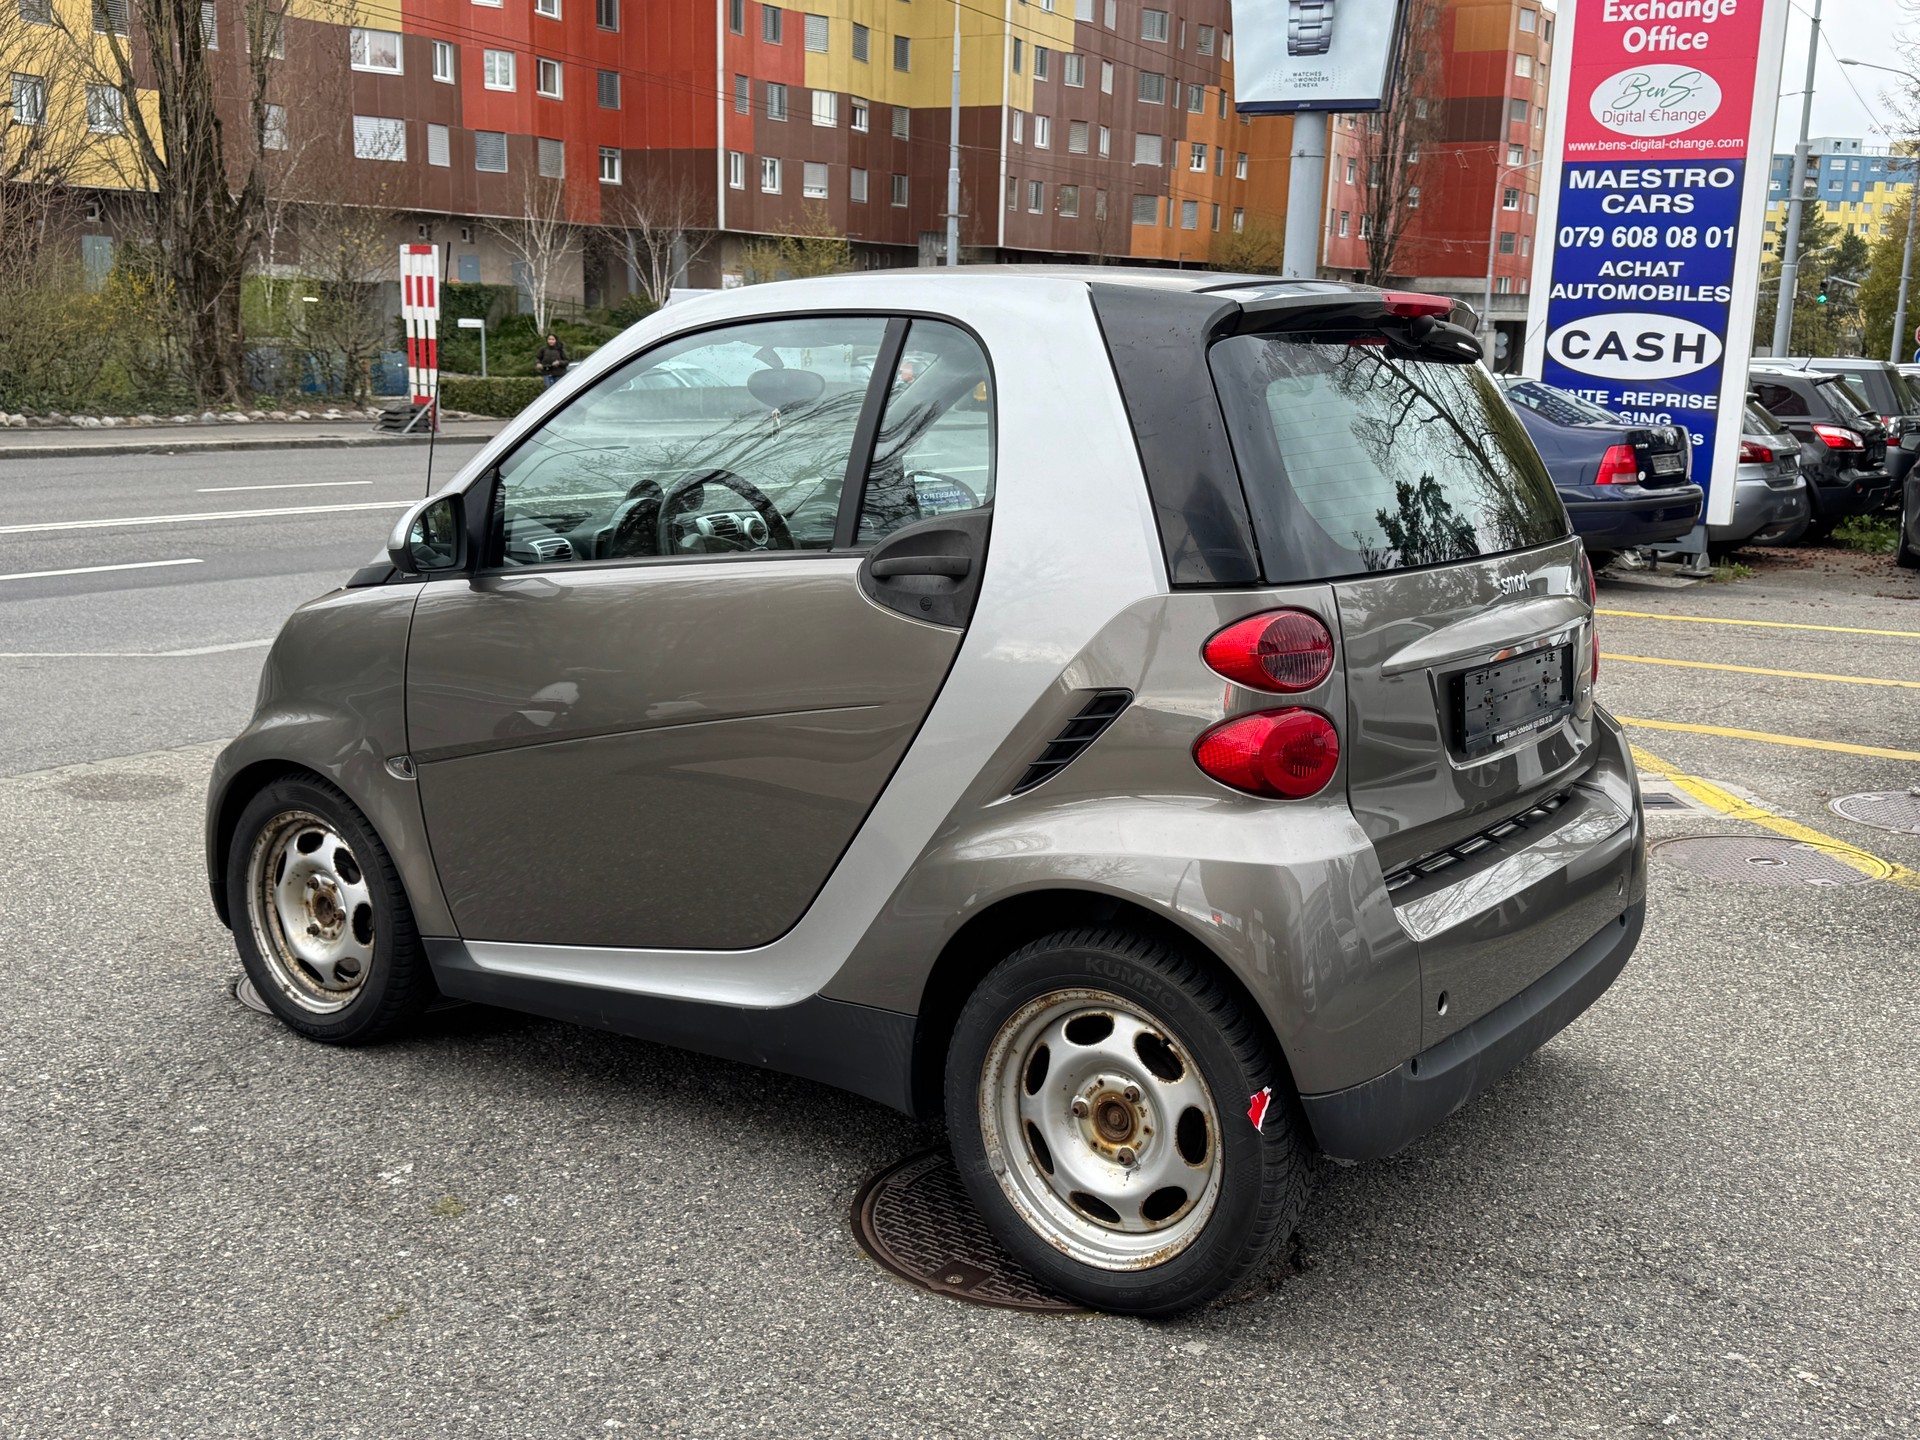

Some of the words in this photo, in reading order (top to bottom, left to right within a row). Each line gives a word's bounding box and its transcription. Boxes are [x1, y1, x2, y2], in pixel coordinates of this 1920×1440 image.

[1602, 0, 1738, 24] Exchange
[1623, 25, 1709, 53] Office
[1602, 110, 1645, 126] Digital
[1568, 137, 1744, 152] www.bens-digital-change.com
[1569, 167, 1735, 190] MAESTRO
[1601, 193, 1695, 215] CARS
[1559, 226, 1604, 248] 079
[1611, 226, 1658, 248] 608
[1665, 226, 1697, 248] 08
[1705, 226, 1735, 248] 01
[1598, 261, 1685, 278] ACHAT
[1550, 283, 1732, 303] AUTOMOBILES
[1561, 329, 1707, 365] CASH
[1501, 570, 1530, 596] smart
[1085, 957, 1179, 1012] KUMHO
